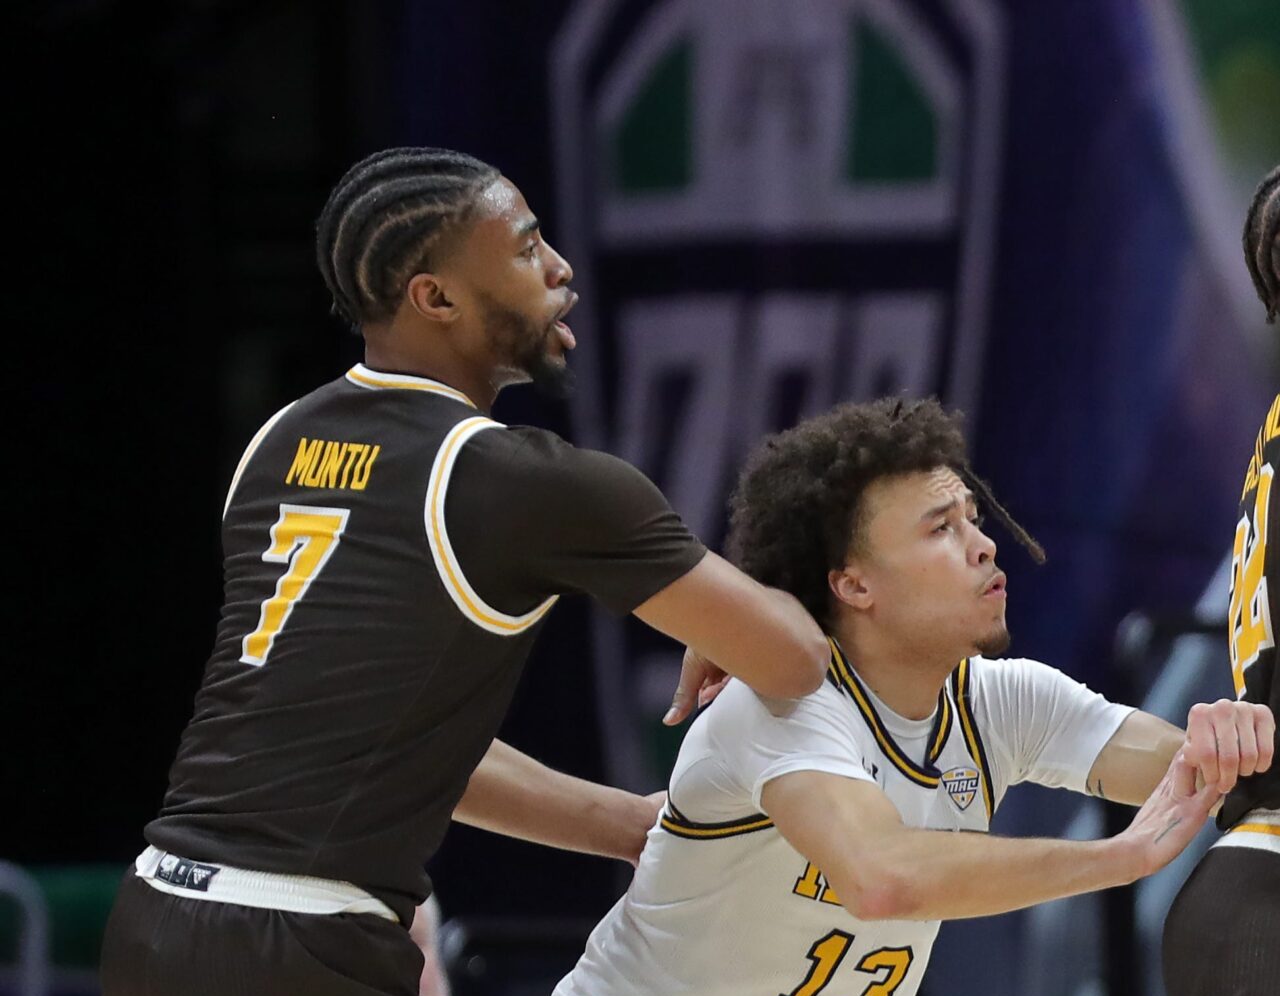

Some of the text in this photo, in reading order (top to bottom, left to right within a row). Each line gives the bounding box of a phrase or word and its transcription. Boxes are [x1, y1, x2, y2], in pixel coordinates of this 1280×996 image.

[285, 437, 381, 490] MUNTU
[239, 503, 350, 667] 7
[944, 779, 978, 793] MAC
